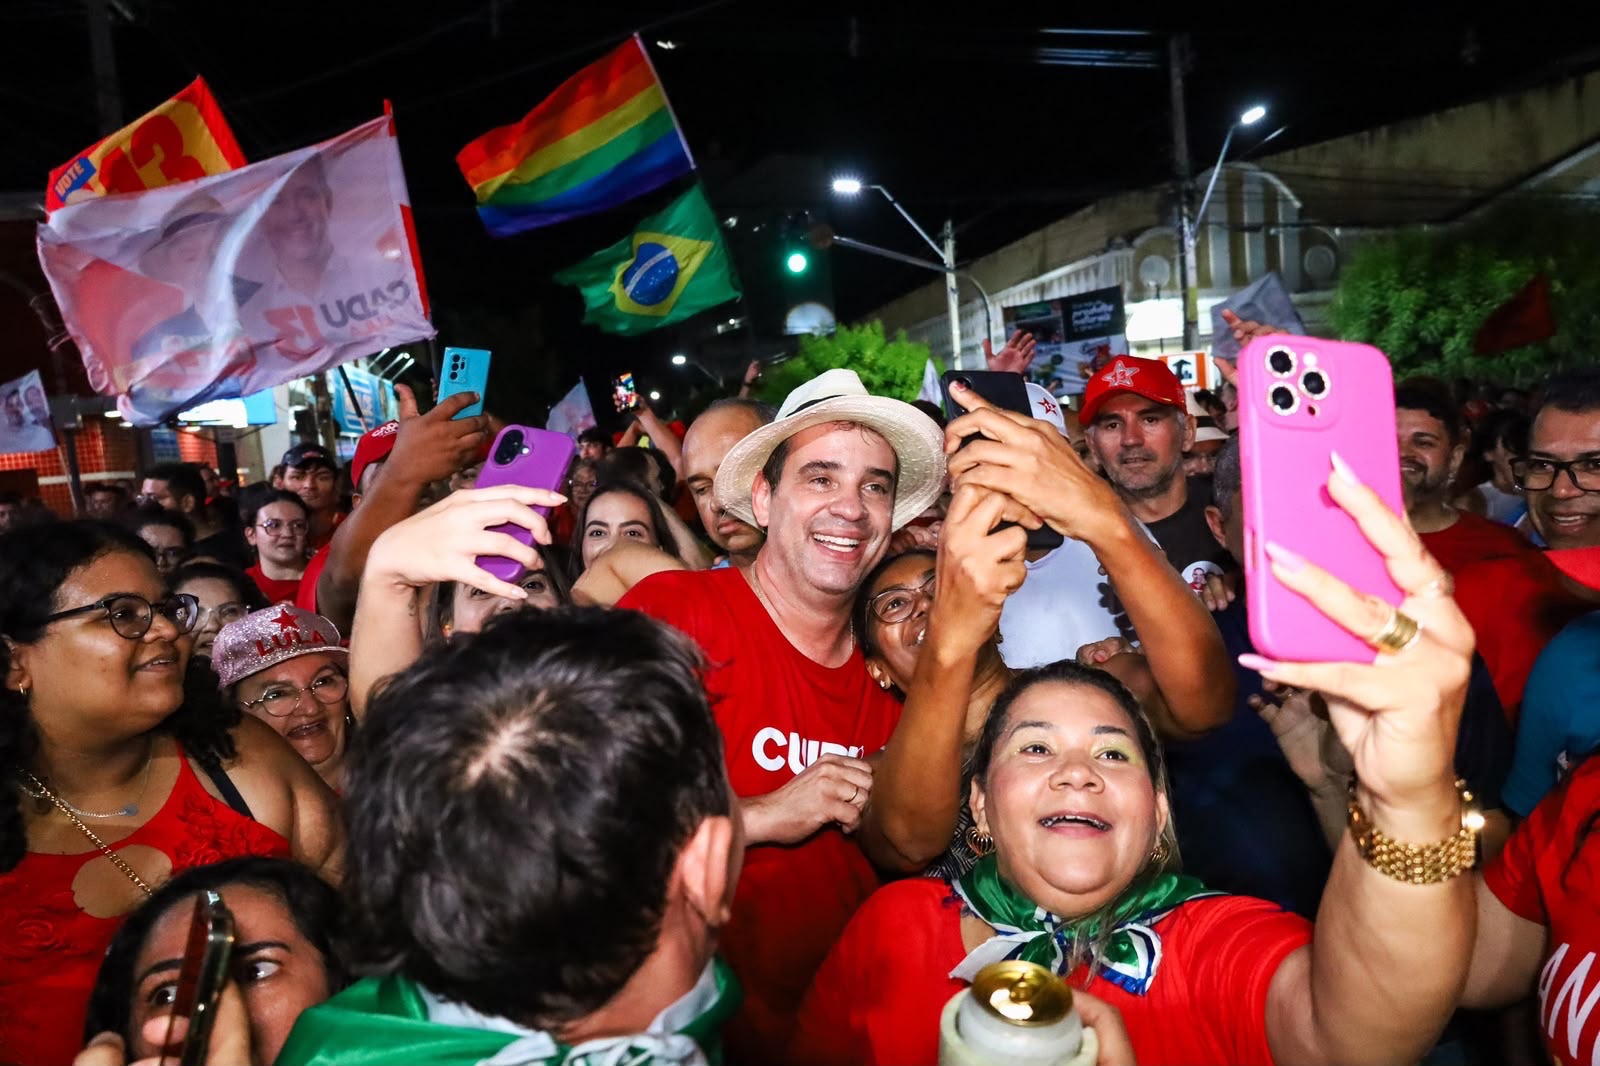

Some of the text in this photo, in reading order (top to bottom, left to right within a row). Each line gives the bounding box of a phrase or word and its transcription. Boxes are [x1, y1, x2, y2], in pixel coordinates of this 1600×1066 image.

[99, 113, 208, 194] 13
[55, 161, 86, 196] VOTE
[255, 630, 328, 657] LULA
